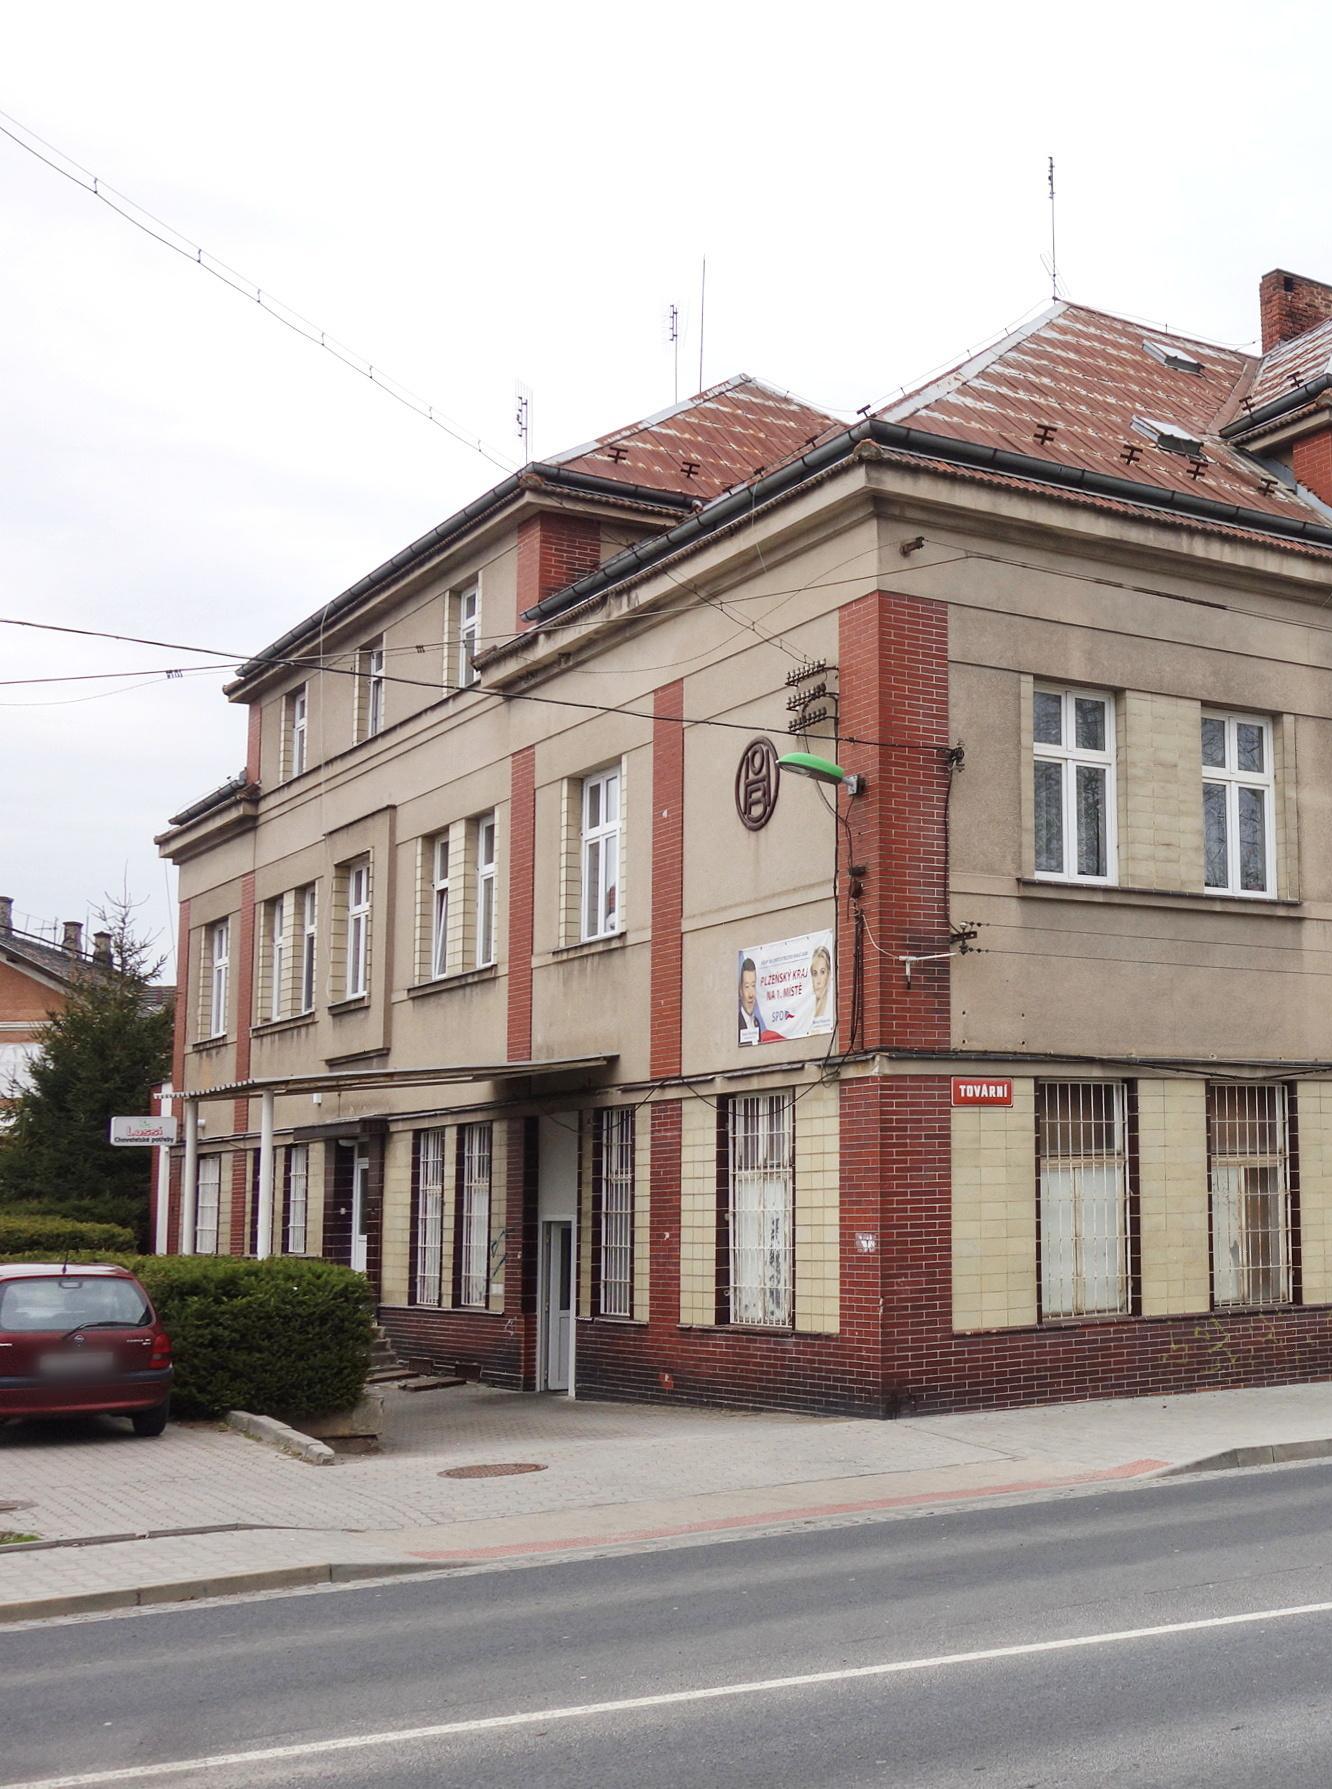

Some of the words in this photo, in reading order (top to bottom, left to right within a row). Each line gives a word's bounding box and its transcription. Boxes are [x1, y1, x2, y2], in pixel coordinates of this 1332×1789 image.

[793, 968, 808, 978] KRAJ
[766, 989, 775, 1000] NA
[959, 1083, 1008, 1098] TOVÁRNÍ
